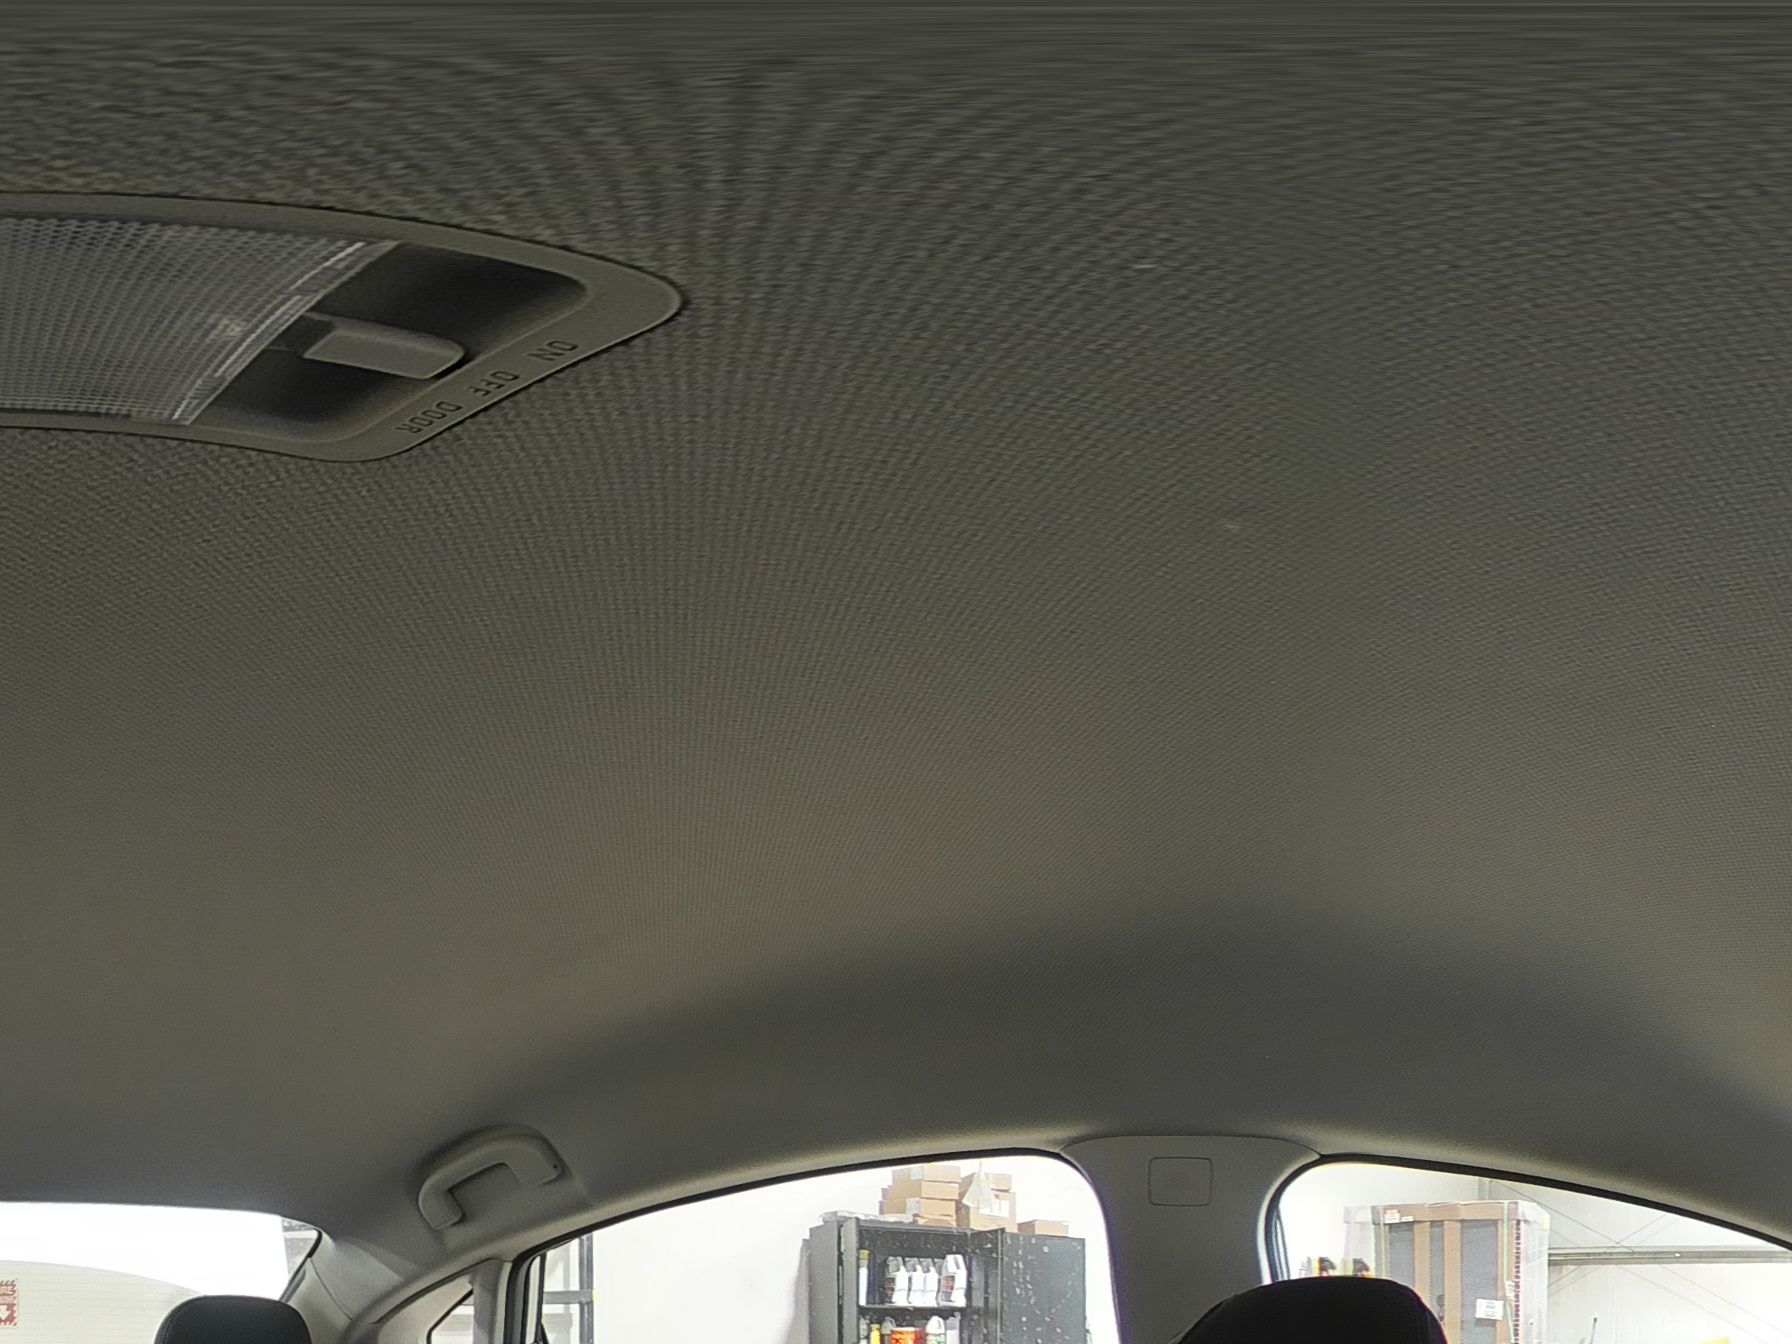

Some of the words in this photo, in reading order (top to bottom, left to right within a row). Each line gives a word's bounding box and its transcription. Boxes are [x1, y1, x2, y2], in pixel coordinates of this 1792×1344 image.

[526, 340, 578, 361] ON
[467, 371, 519, 396] OFF
[395, 401, 463, 434] DOOR
